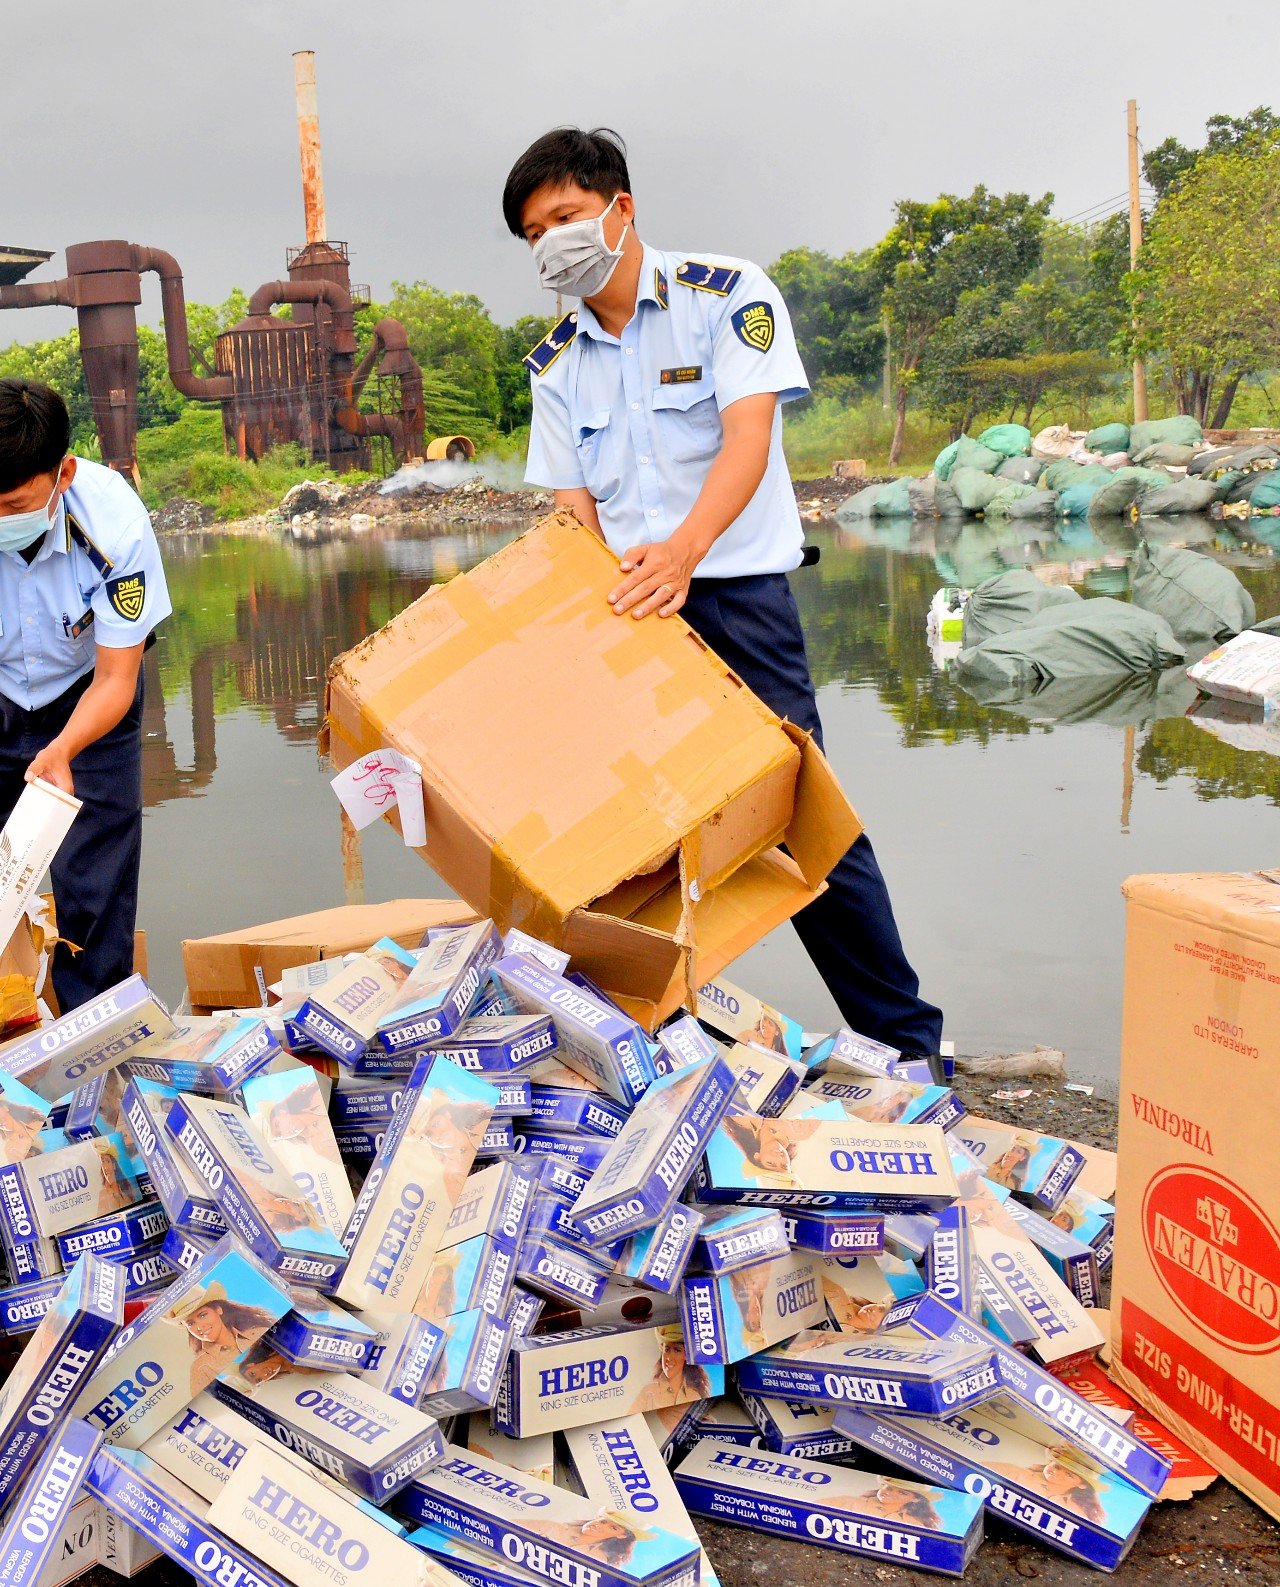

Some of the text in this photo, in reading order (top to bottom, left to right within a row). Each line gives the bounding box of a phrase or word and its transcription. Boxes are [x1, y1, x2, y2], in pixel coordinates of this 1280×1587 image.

[743, 306, 765, 321] DMS
[118, 578, 139, 590] DMS
[15, 864, 34, 894] JET
[1184, 946, 1214, 962] CARRERAS
[1209, 964, 1246, 982] MADE BY BAT
[1213, 957, 1222, 965] OF
[1219, 949, 1240, 962] UNITED
[1222, 959, 1255, 975] AUTHORITY
[1254, 970, 1266, 979] THE
[451, 966, 480, 1017] HERO
[550, 988, 612, 1027] HERO
[304, 1008, 357, 1052] HERO
[387, 1017, 442, 1046] HERO
[510, 1031, 553, 1064] HERO
[1207, 1015, 1243, 1039] LONDON
[1212, 1032, 1259, 1060] CARRERAS
[220, 1033, 269, 1077] HERO
[616, 1040, 646, 1095] HERO
[814, 1081, 872, 1100] HERO
[127, 1098, 157, 1157] HERO
[830, 1137, 928, 1149] KING SIZE CIGARETTES
[1131, 1093, 1213, 1156] VIRGINIA
[179, 1120, 224, 1191] HERO
[654, 1121, 698, 1191] HERO
[830, 1149, 937, 1176] HERO
[2, 1172, 32, 1236] HERO
[39, 1164, 88, 1202] HERO
[502, 1175, 530, 1238] HERO
[582, 1199, 645, 1234] HERO
[363, 1182, 425, 1296] HERO
[650, 1213, 688, 1282] HERO
[715, 1226, 780, 1258] HERO
[830, 1231, 879, 1247] HERO
[278, 1256, 336, 1278] HERO
[483, 1250, 510, 1314] HERO
[538, 1258, 599, 1299] HERO
[933, 1230, 960, 1300] HERO
[1155, 1212, 1279, 1322] CRAVEN
[775, 1277, 817, 1318] HERO
[991, 1253, 1069, 1339] HERO
[693, 1285, 717, 1356] HERO
[307, 1334, 367, 1359] HERO
[1134, 1332, 1172, 1379] SIZE
[27, 1342, 95, 1427] HERO
[538, 1355, 629, 1398] HERO
[824, 1373, 908, 1408] HERO
[941, 1366, 997, 1405] HERO
[111, 1382, 175, 1440] SIZE CIGARETTES
[295, 1389, 391, 1445] HERO
[540, 1386, 625, 1412] KING SIZE CIGARETTES
[876, 1425, 953, 1470] TOBACCOS VIRGINIA
[926, 1418, 985, 1452] CIGARETTES
[1034, 1383, 1136, 1469] HERO
[382, 1440, 439, 1490] HERO
[601, 1428, 659, 1513] HERO
[706, 1463, 818, 1493] KING SIZE CIGARETTES
[708, 1450, 832, 1486] HERO
[869, 1431, 955, 1482] FINEST WITH BLENDED
[21, 1446, 83, 1544] HERO
[437, 1457, 552, 1508] HERO
[116, 1489, 189, 1549] BLENDED WITH FINEST
[126, 1481, 191, 1536] VIRGINIA TOBACCOS
[248, 1475, 370, 1572] HERO
[424, 1498, 491, 1534] TOBACCOS VIRGINIA
[710, 1502, 797, 1528] FINEST WITH BLENDED
[713, 1493, 793, 1517] TOBACCOS VIRGINIA
[963, 1472, 1080, 1547] HERO
[241, 1506, 348, 1587] KING SIZE CIGARETTES
[805, 1513, 921, 1561] HERO
[501, 1533, 602, 1587] HERO
